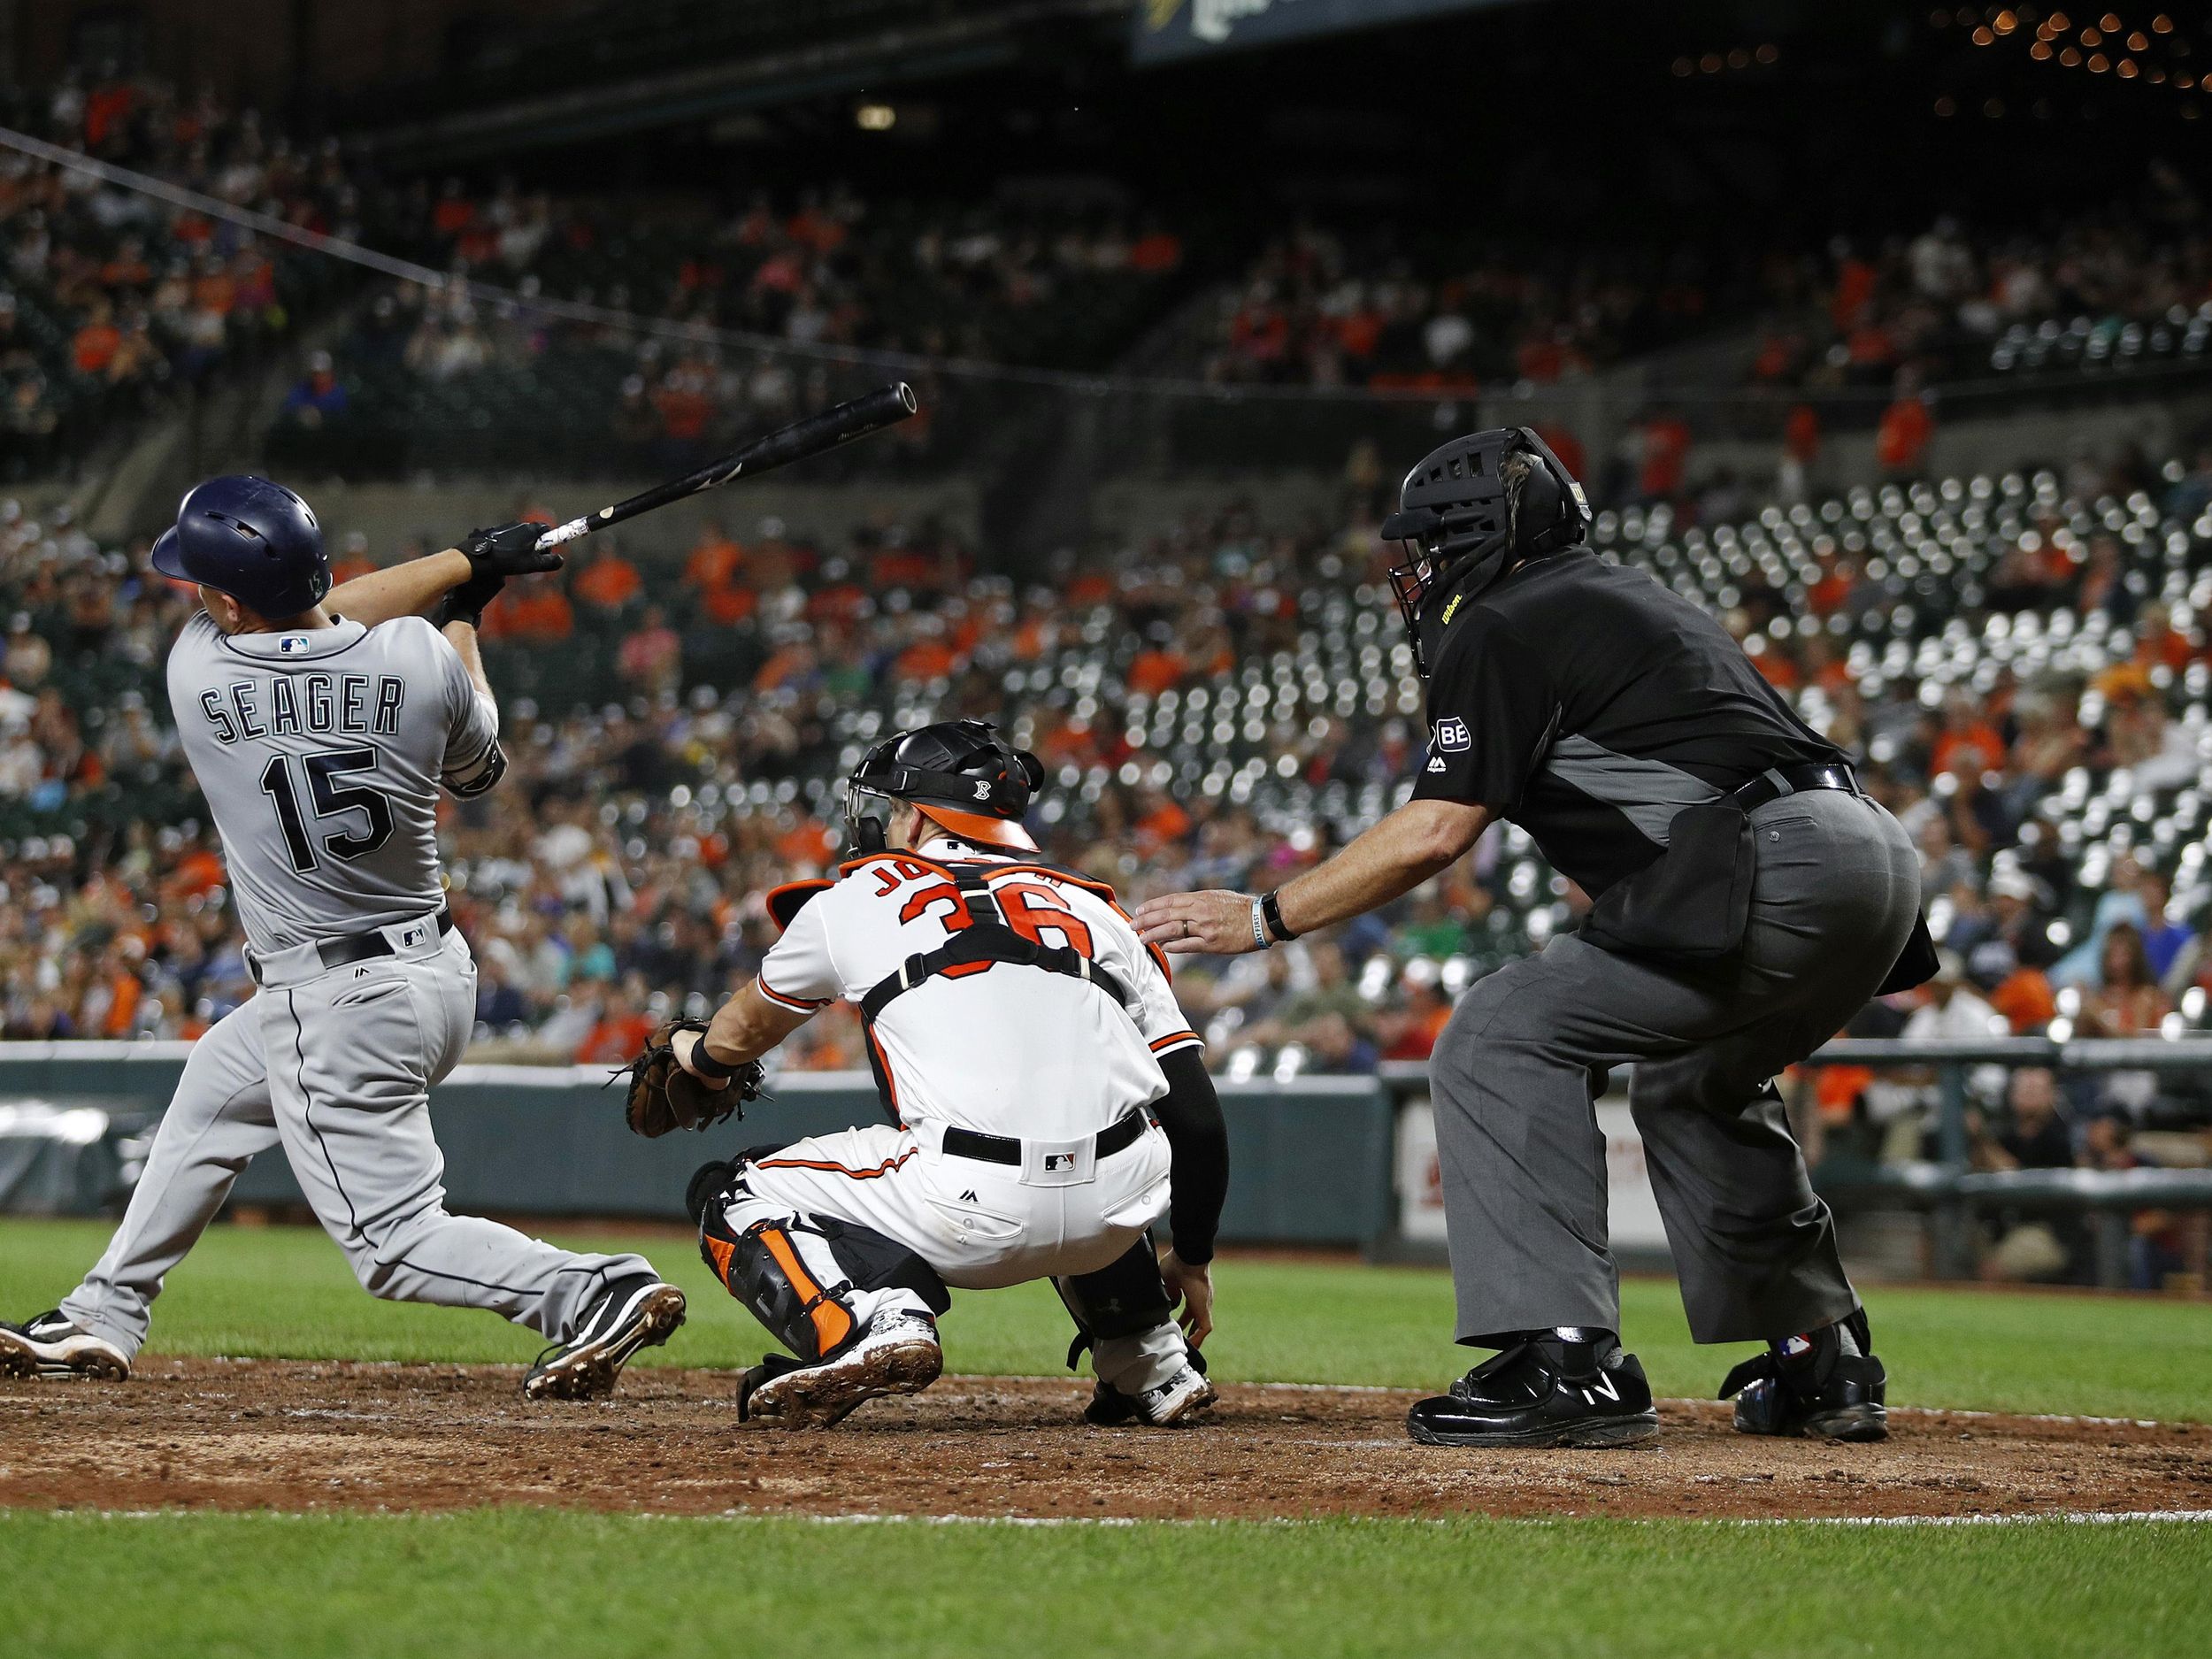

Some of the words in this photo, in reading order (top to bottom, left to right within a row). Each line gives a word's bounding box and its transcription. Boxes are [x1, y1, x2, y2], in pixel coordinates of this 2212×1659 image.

[1441, 594, 1463, 625] Wilson
[198, 673, 405, 745] SEAGER
[1440, 724, 1469, 745] BE
[259, 746, 396, 875] 15
[898, 881, 1095, 980] 36
